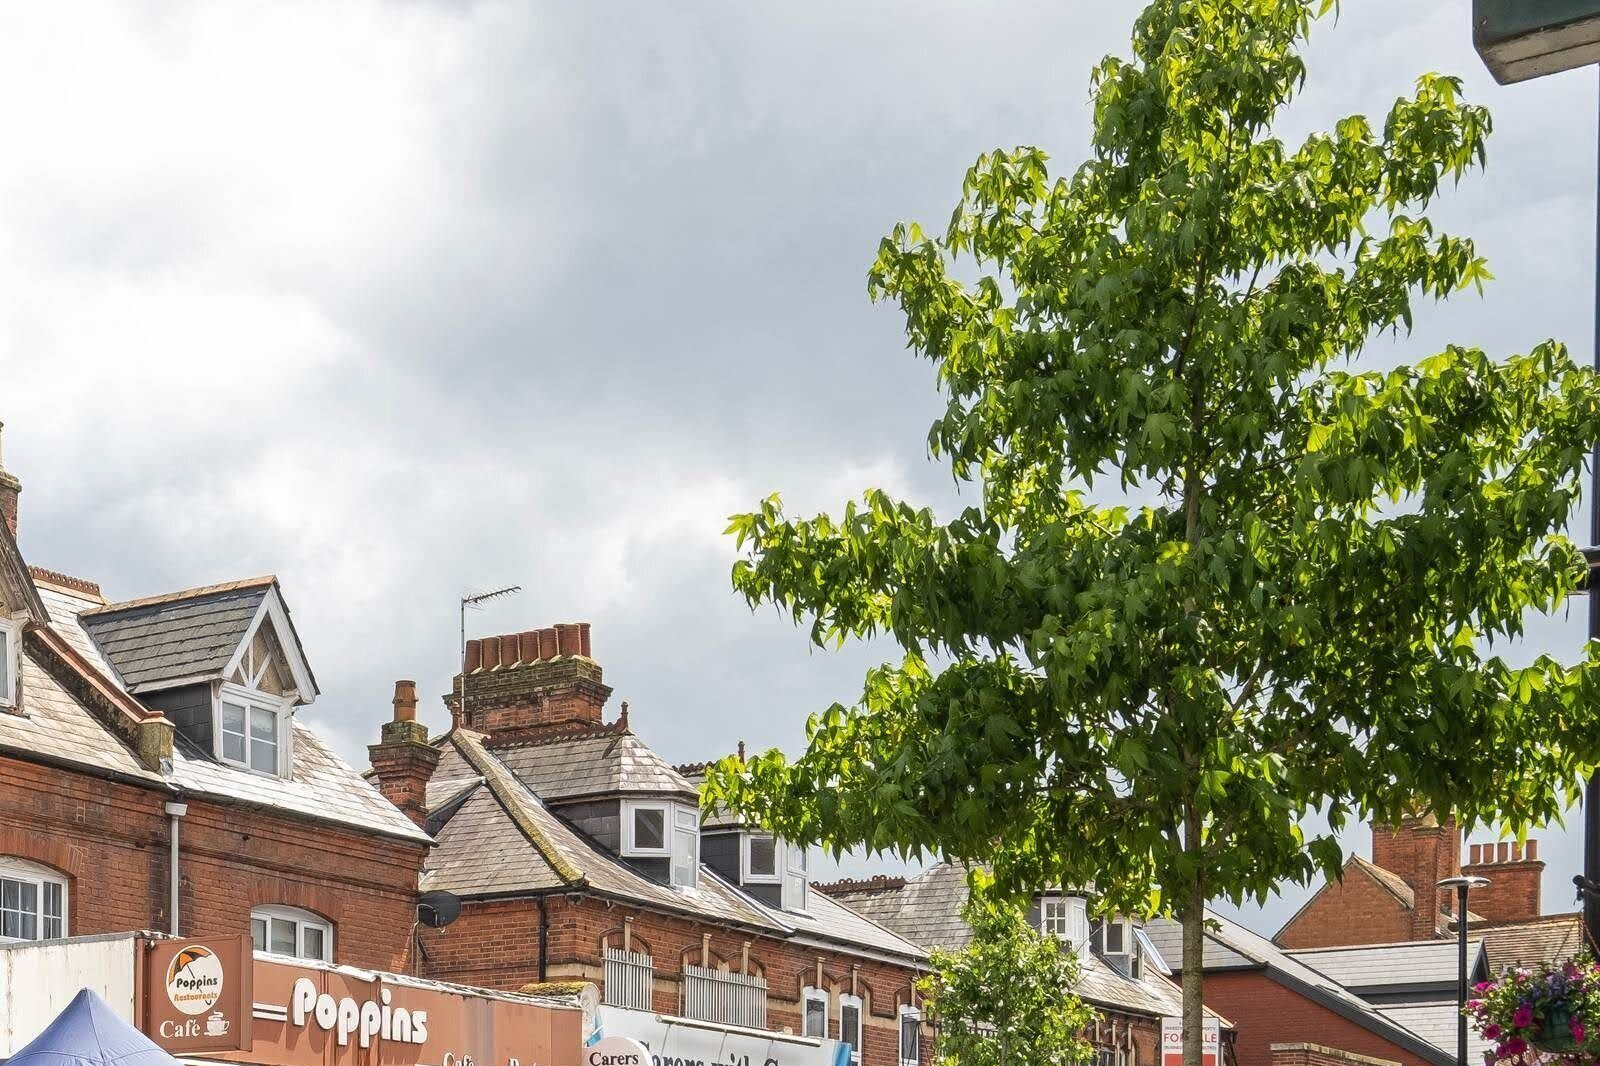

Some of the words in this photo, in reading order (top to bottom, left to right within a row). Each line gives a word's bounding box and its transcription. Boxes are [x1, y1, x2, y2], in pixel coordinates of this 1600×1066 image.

[176, 975, 218, 990] Poppins
[293, 977, 428, 1048] Poppins
[160, 1019, 200, 1038] Café
[589, 1052, 639, 1066] Carers
